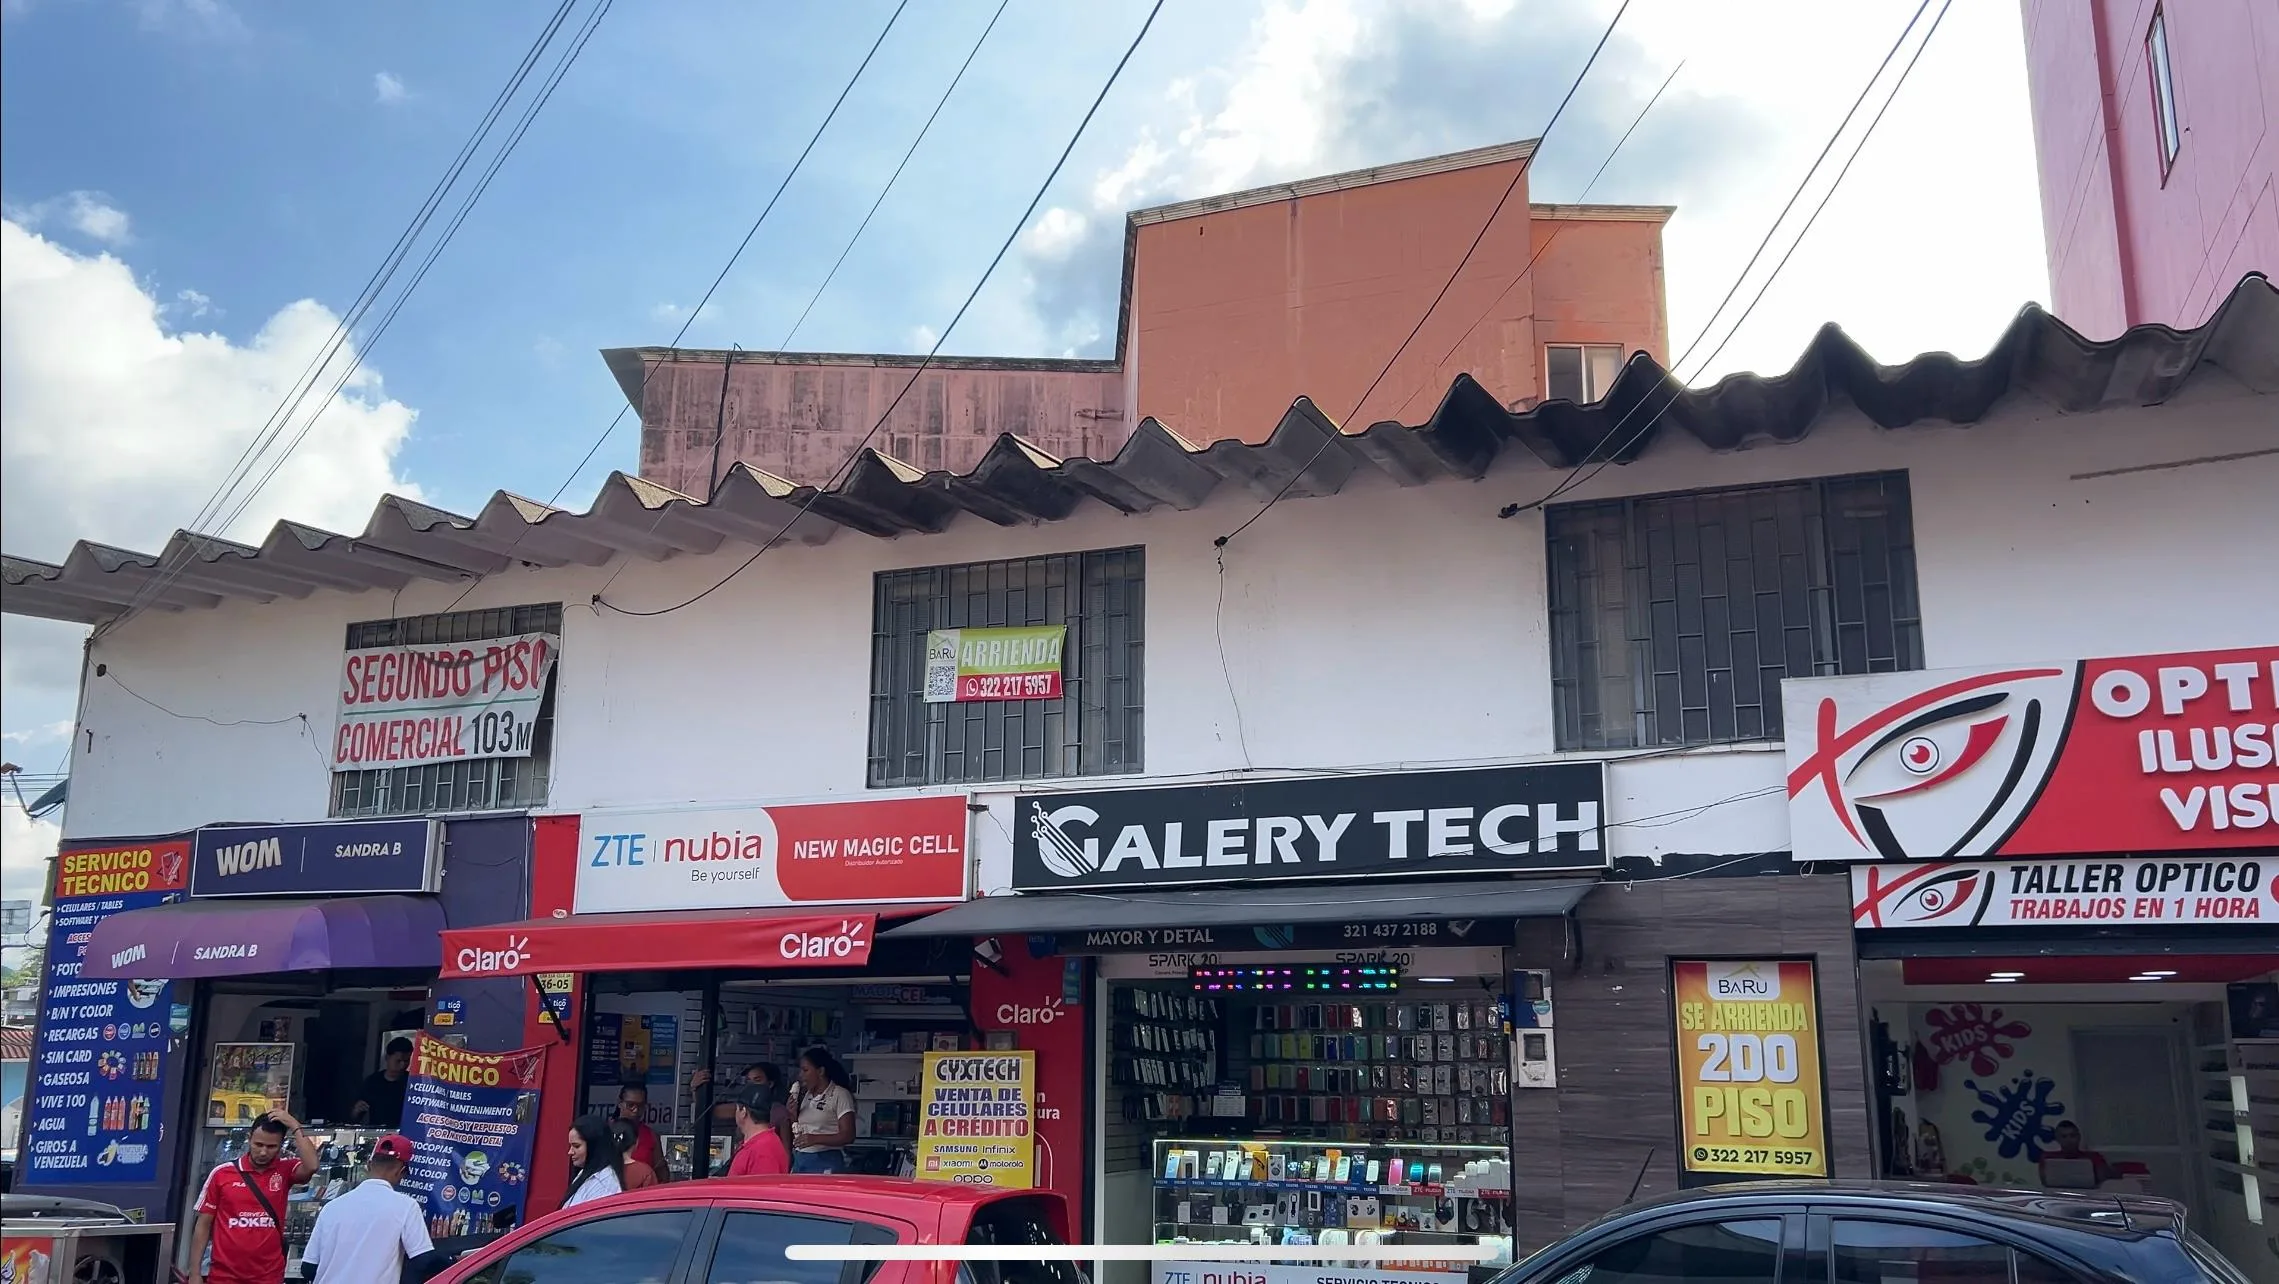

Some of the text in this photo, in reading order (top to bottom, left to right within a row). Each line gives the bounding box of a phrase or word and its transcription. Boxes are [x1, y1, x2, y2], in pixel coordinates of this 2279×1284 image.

[961, 637, 1060, 667] ARRIENDA
[343, 639, 547, 705] SEGUNDO PISO
[980, 674, 1052, 697] 322 217 5957
[336, 710, 532, 764] COMERCIAL 103 M
[1033, 800, 1599, 877] GALERY TECH
[335, 842, 402, 858] SANDRA B
[591, 831, 762, 868] ZTE nubia
[793, 834, 960, 860] NEW MAGIC CELL
[63, 849, 152, 873] SERVICIO
[216, 837, 282, 877] WOM
[63, 870, 150, 895] TECNICO
[691, 866, 760, 884] Be yourself
[2010, 862, 2261, 895] TALLER OPTICO
[61, 901, 96, 913] CELULARES
[101, 900, 124, 910] TABLES
[2010, 897, 2260, 920] TRABAJOS EN 1 HORA
[59, 916, 92, 927] SOFTWARE
[92, 916, 100, 925] Y
[1086, 928, 1214, 946] MAYOR Y DETAL
[1343, 922, 1438, 938] 321 437 2188
[780, 925, 858, 960] Claro
[111, 944, 147, 969] WOM
[193, 944, 258, 960] SANDRA B
[457, 941, 525, 972] Claro
[1148, 953, 1196, 967] SPARK
[1201, 953, 1218, 965] 20
[1392, 952, 1410, 966] 20
[53, 982, 118, 998] IMPRESIONES
[50, 1004, 114, 1020] B/N Y COLOR
[997, 999, 1059, 1024] Claro
[1681, 1002, 1809, 1032] SE ARRIENDA
[48, 1027, 99, 1042] RECARGAS
[1940, 1024, 1988, 1052] KIDS
[45, 1049, 92, 1065] SIM CARD
[1697, 1033, 1800, 1083] 2DO
[418, 1056, 500, 1086] TECNICO
[936, 1058, 1021, 1082] CYXTECH
[43, 1072, 90, 1086] GASEOSA
[41, 1094, 86, 1109] VIVE 100
[449, 1090, 472, 1101] TABLES
[934, 1087, 1021, 1102] VENTA DE
[450, 1104, 513, 1117] MANTENIMIENTO
[927, 1102, 1028, 1117] CELULARES
[1035, 1107, 1060, 1120] ura
[1693, 1086, 1809, 1139] PISO
[38, 1118, 66, 1131] AGUA
[923, 1117, 1029, 1137] A CRÉDITO
[2001, 1100, 2035, 1140] KIDS
[465, 1122, 472, 1132] Y
[472, 1122, 519, 1135] REPUESTOS
[427, 1128, 448, 1139] POR
[474, 1134, 482, 1145] Y
[481, 1136, 503, 1147] DETAL
[35, 1140, 77, 1154] GIROS A
[933, 1145, 978, 1153] SAMSUNG
[33, 1155, 88, 1169] VENEZUELA
[942, 1160, 973, 1168] xiaomi
[989, 1160, 1024, 1168] motorola
[1711, 1148, 1812, 1165] 322 217 5957
[419, 1169, 448, 1180] COLOR
[400, 1178, 435, 1192] RECARGAS
[228, 1217, 276, 1229] POKER
[1203, 1271, 1267, 1284] nubia
